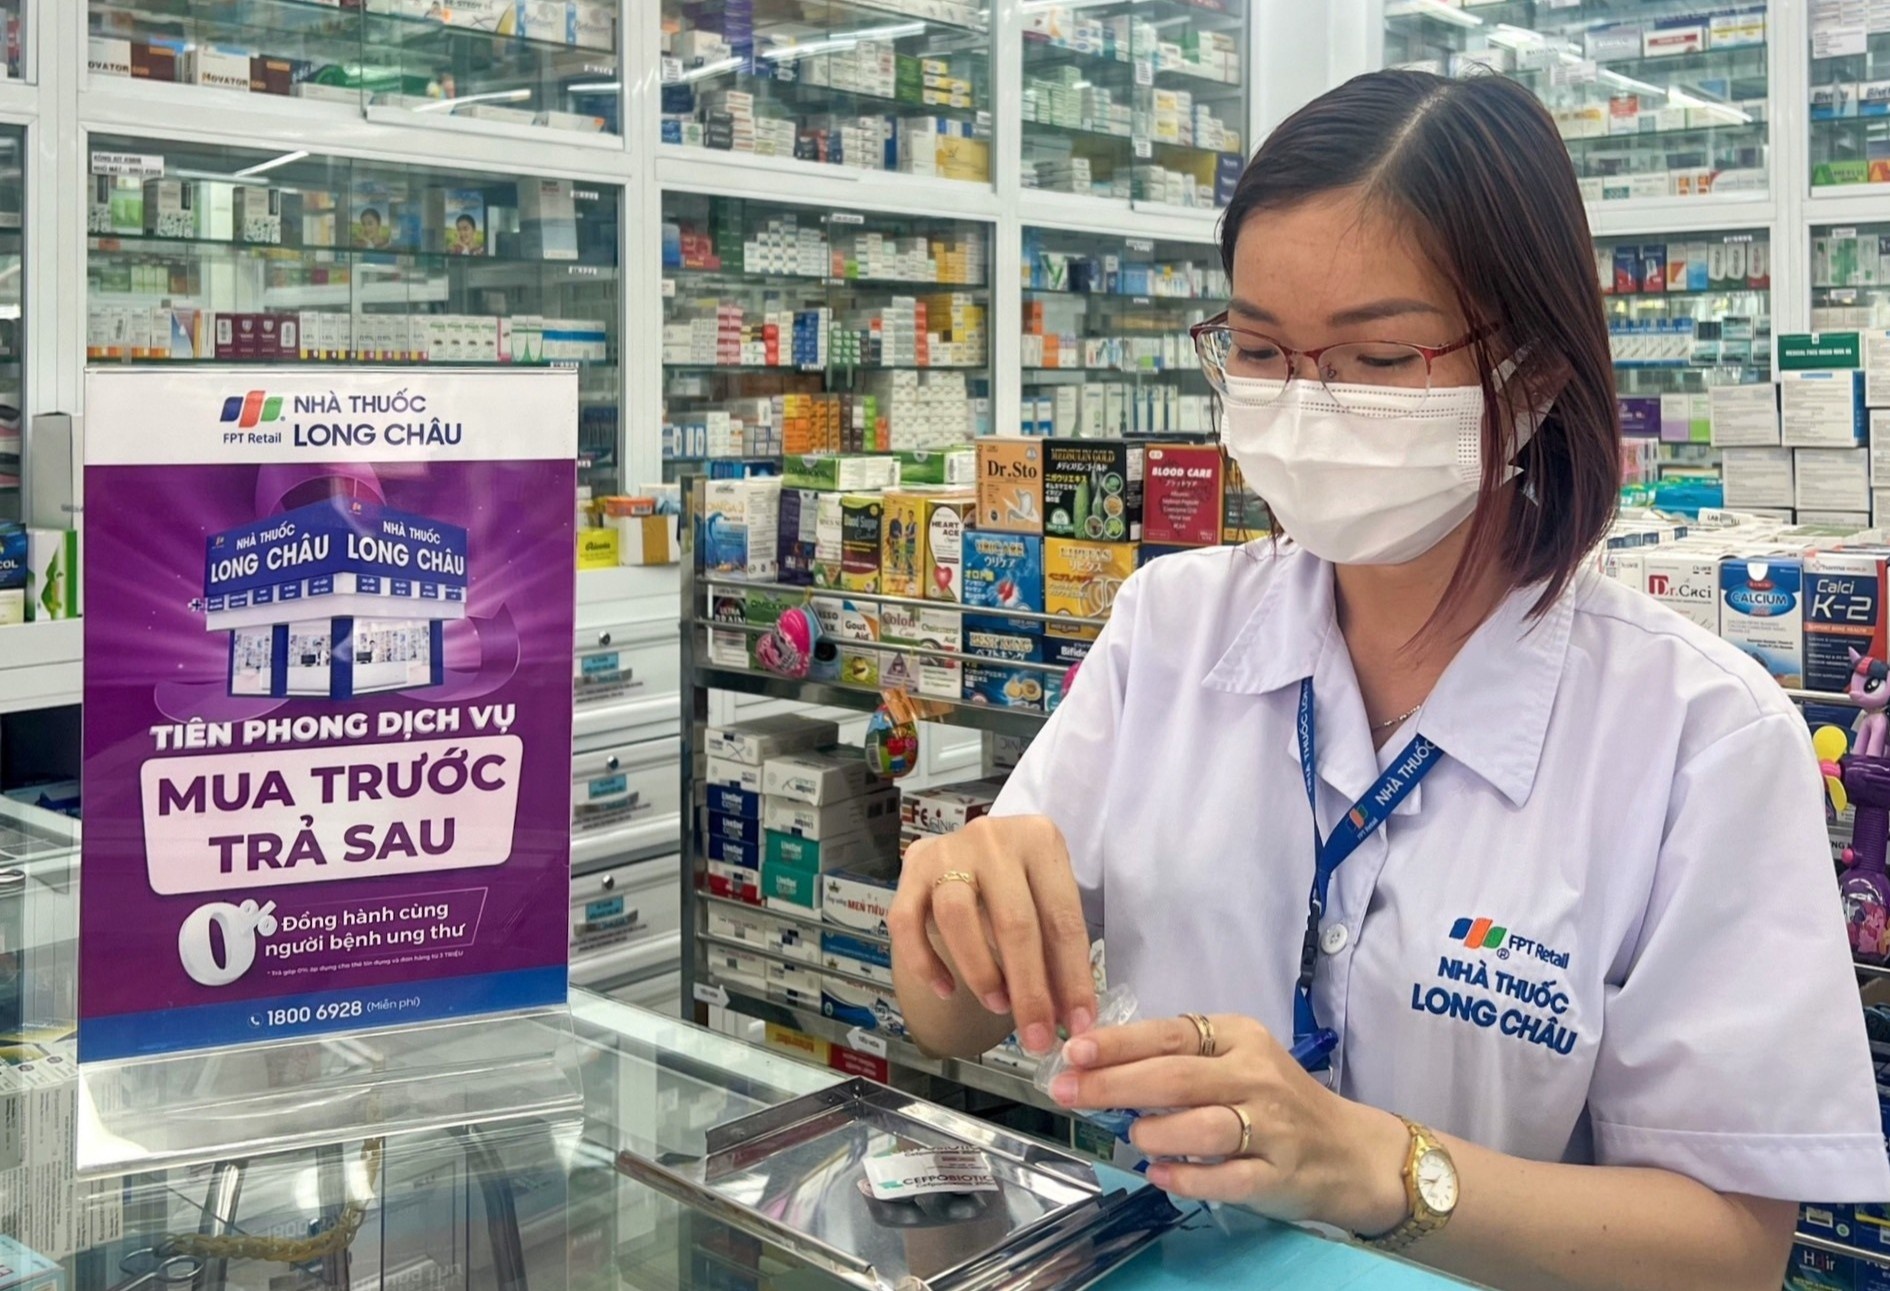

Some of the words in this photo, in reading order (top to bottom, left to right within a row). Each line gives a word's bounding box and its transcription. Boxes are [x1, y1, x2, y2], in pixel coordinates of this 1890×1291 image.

[294, 390, 342, 414] NHÀ
[348, 387, 427, 414] THUỐC
[223, 431, 245, 444] FPT
[247, 431, 283, 445] Retail
[294, 422, 377, 447] LONG
[383, 416, 463, 446] CHÂU
[987, 460, 1037, 479] Dr.Sto
[1151, 466, 1185, 477] BLOOD
[1186, 467, 1213, 478] CARE
[236, 531, 257, 551] NHÀ
[260, 520, 296, 544] THUỐC
[383, 520, 406, 538] NHÀ
[408, 526, 441, 545] THUỐC
[931, 520, 960, 530] HEART
[942, 528, 960, 537] ACE
[210, 552, 260, 584] LONG
[266, 532, 330, 571] CHÂU
[347, 532, 410, 568] LONG
[416, 547, 465, 576] CHÂU
[983, 556, 1017, 568] ウリケア
[1730, 591, 1788, 606] CALCIUM
[1816, 578, 1856, 595] Calci
[882, 610, 917, 628] Colon
[1811, 593, 1873, 621] K-2
[844, 619, 867, 631] Gout
[854, 631, 870, 641] Aid
[149, 716, 233, 751] TIÊN
[242, 712, 369, 746] PHONG
[377, 706, 461, 741] DỊCH
[468, 702, 516, 734] VỤ
[158, 769, 296, 817] MUA
[310, 746, 507, 805] TRƯỚC
[1374, 775, 1405, 807] NHÀ
[1397, 740, 1437, 780] THUỐC
[208, 813, 328, 874] TRẢ
[342, 816, 456, 863] SAU
[280, 909, 337, 933] Đồng
[343, 904, 395, 927] hành
[399, 901, 449, 921] cùng
[847, 899, 866, 913] MEN
[178, 898, 279, 987] 0%
[264, 932, 324, 958] người
[329, 928, 382, 953] bệnh
[386, 926, 426, 945] ung
[429, 921, 467, 940] thư
[1508, 933, 1536, 956] FPT
[1534, 943, 1571, 970] Retail
[1437, 955, 1490, 990] NHÀ
[1495, 970, 1570, 1015] THUỐC
[266, 1005, 311, 1026] 1800
[315, 1000, 363, 1022] 6928
[366, 997, 398, 1014] (Miễn
[398, 996, 421, 1010] phí)
[1411, 983, 1498, 1028] LONG
[1500, 1008, 1579, 1056] CHÂU
[902, 1173, 994, 1186] CEFPOBIOTIC
